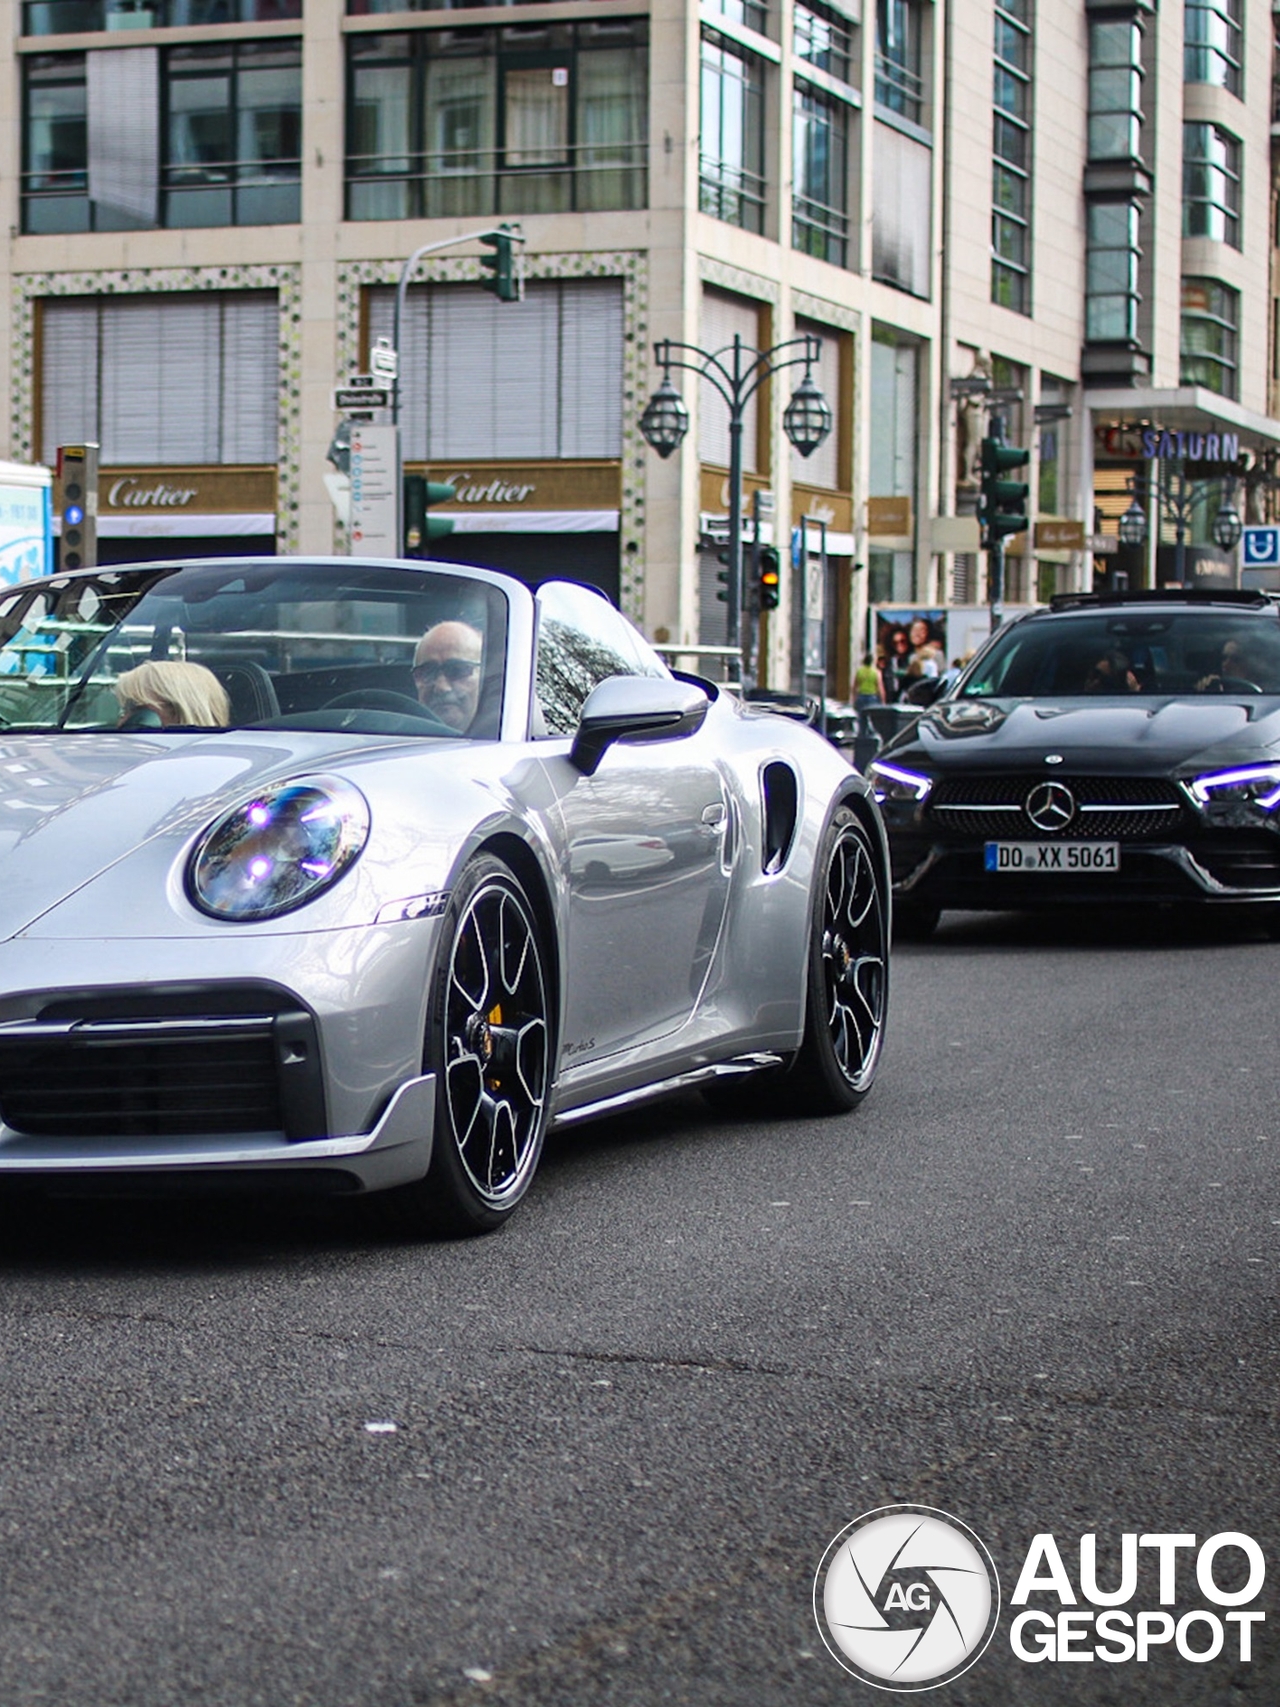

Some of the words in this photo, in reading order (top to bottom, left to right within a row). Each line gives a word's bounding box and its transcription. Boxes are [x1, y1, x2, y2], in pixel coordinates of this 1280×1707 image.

[1142, 430, 1238, 462] SATURN
[108, 477, 198, 507] Cartier
[1249, 533, 1273, 559] U
[999, 847, 1022, 867] DO
[1038, 847, 1061, 867] XX
[1068, 847, 1116, 867] 5061
